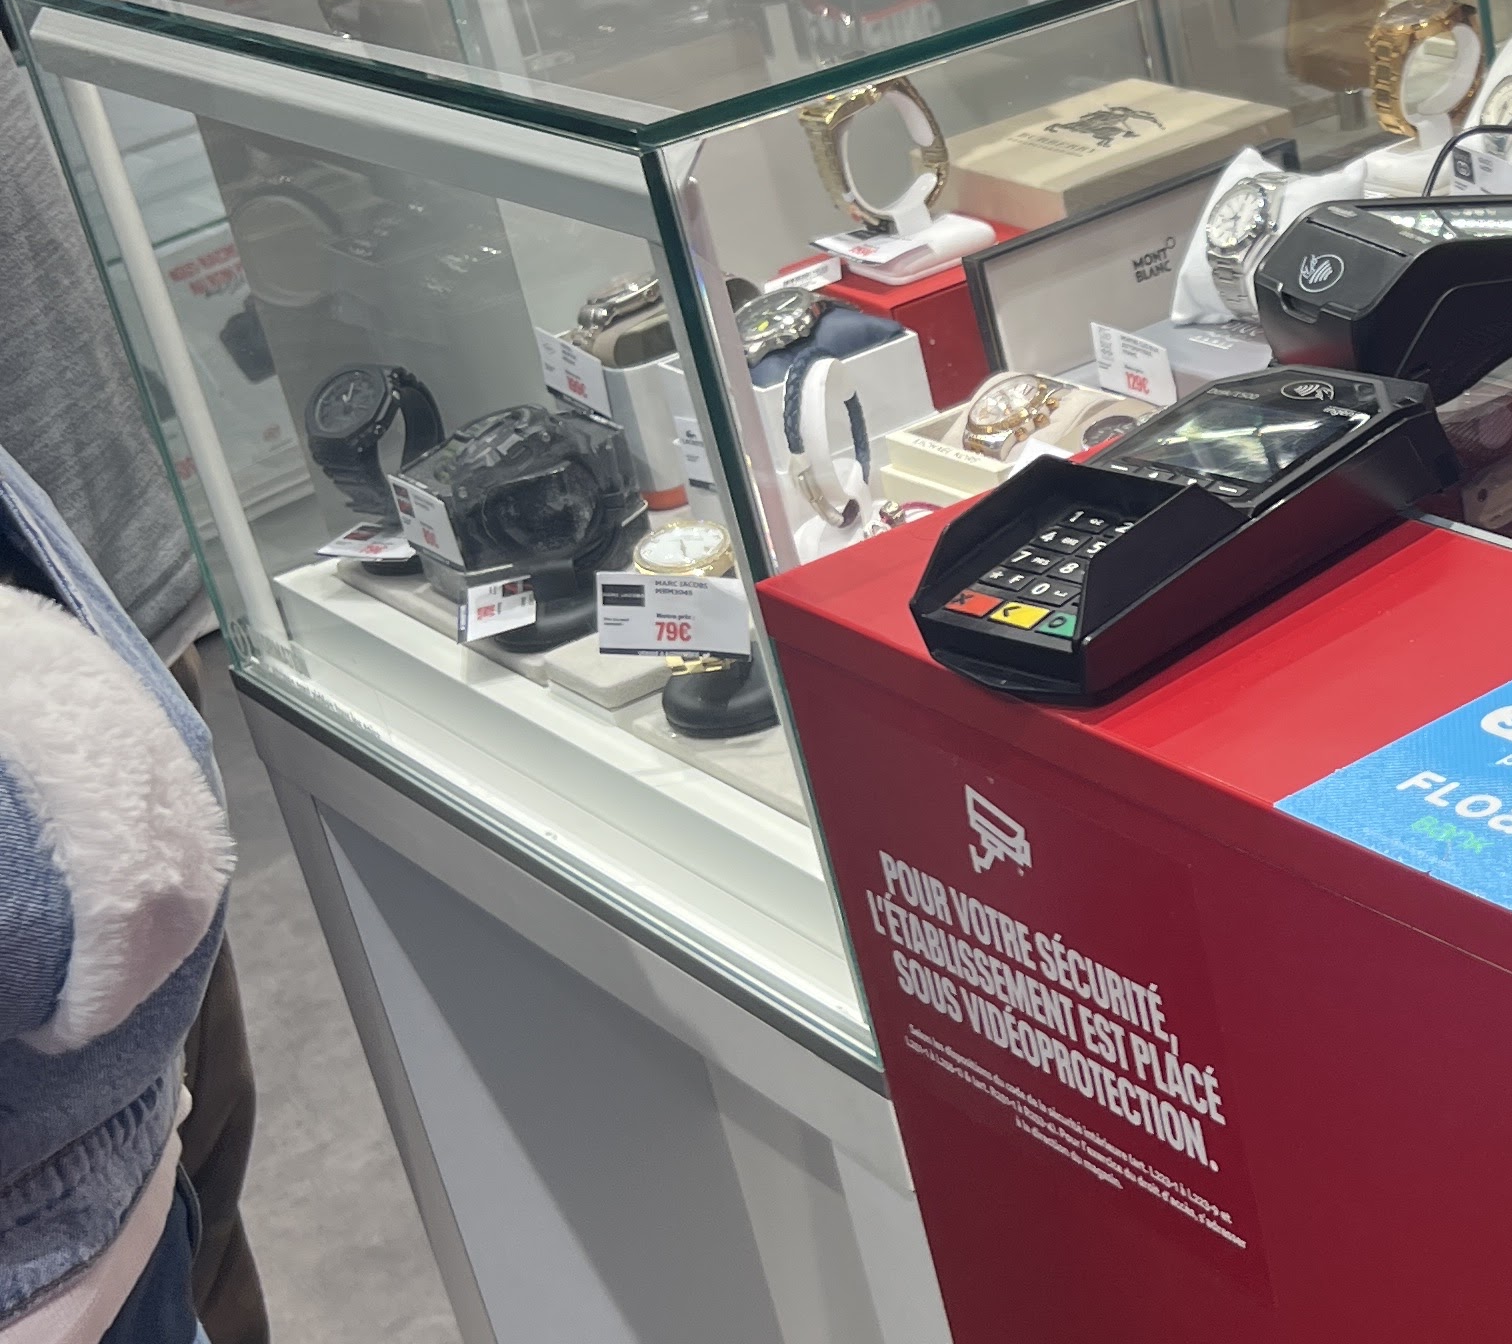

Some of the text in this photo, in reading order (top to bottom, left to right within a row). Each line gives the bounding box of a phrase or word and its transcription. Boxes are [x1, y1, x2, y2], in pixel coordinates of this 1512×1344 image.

[1132, 247, 1169, 271] MONT
[1134, 260, 1172, 284] BLANC
[1069, 511, 1084, 522] 1
[1040, 531, 1057, 542] 4
[1086, 541, 1107, 554] 5
[1011, 550, 1032, 563] 7
[1059, 562, 1079, 574] 8
[679, 581, 708, 589] JACOBS
[1031, 582, 1050, 595] 0
[655, 621, 692, 642] 79€
[879, 850, 1179, 1056] POUR VOTRE SÉCURITÉ,
[866, 890, 1227, 1126] L'ÉTABLISSEMENT EST PLACÉ
[893, 949, 1220, 1173] SOUS VIDÉOPROTECTION.
